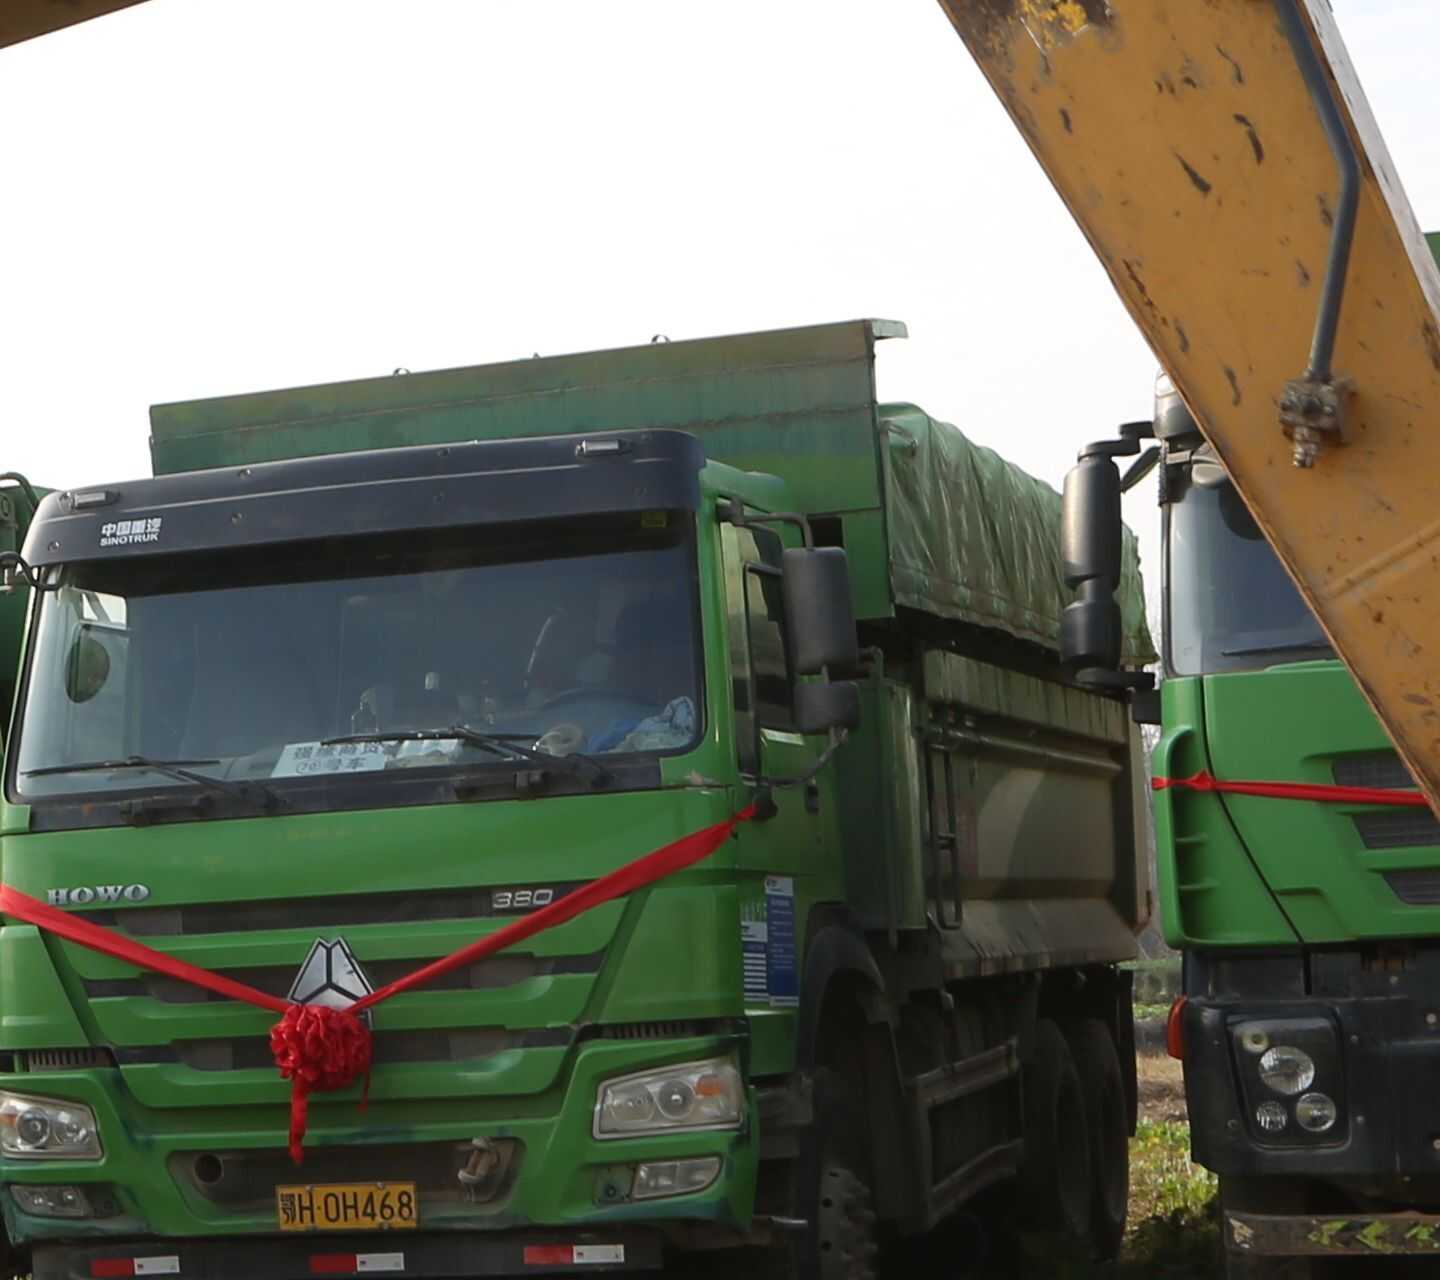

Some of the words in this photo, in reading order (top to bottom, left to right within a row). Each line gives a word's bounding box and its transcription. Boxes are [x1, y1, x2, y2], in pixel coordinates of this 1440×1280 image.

[99, 532, 160, 547] SINOTRUK
[46, 883, 149, 906] HOWO
[492, 888, 553, 909] 380
